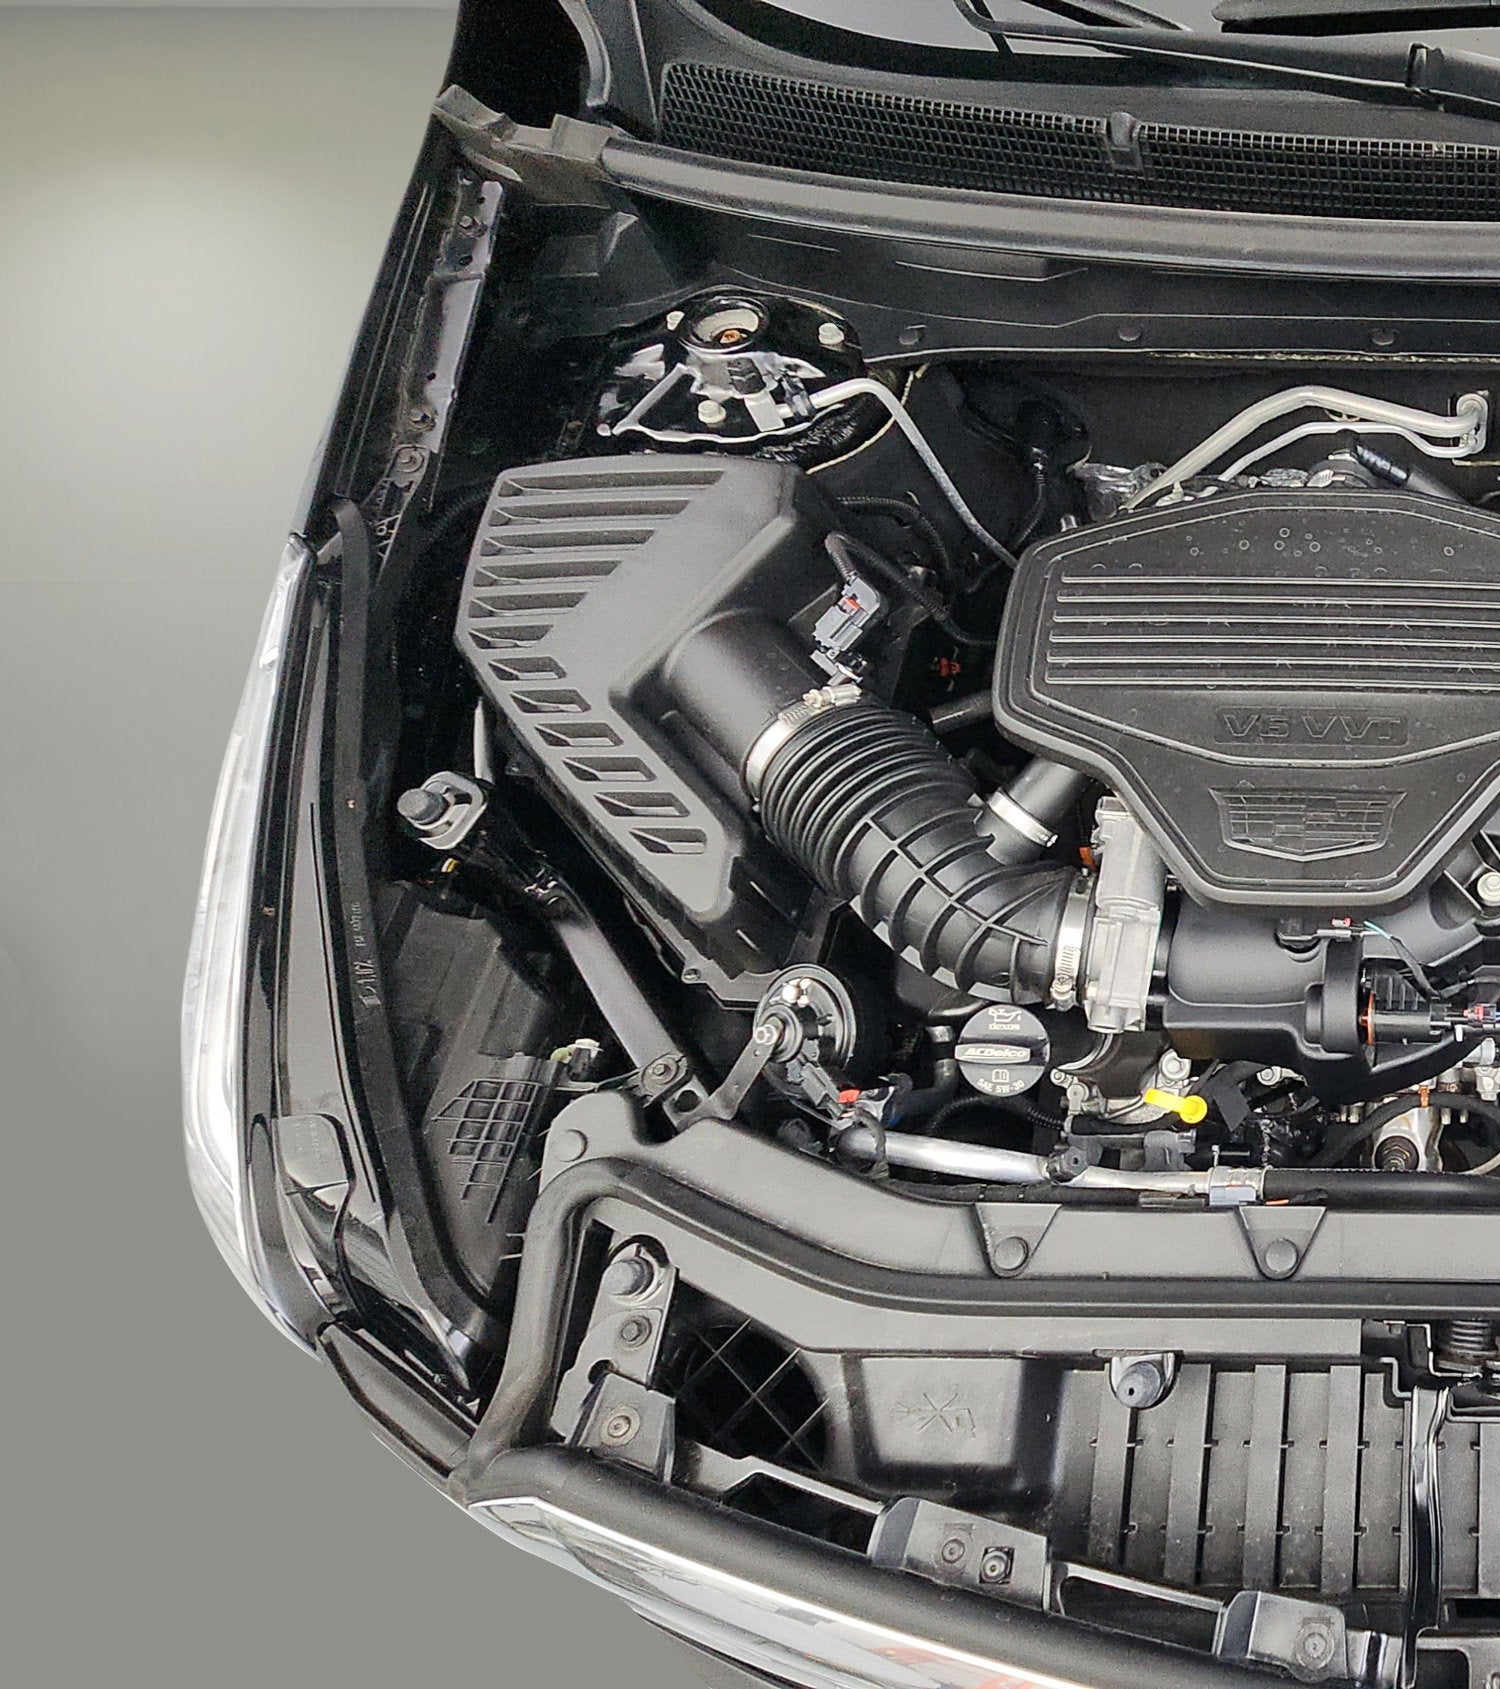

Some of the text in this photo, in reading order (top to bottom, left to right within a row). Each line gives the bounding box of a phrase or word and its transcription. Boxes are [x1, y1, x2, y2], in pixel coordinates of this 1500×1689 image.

[1223, 714, 1401, 740] V6 VVT
[988, 1022, 1020, 1031] dexos
[965, 1047, 1027, 1058] ACDelco
[977, 1078, 1025, 1094] SAE 5W-30
